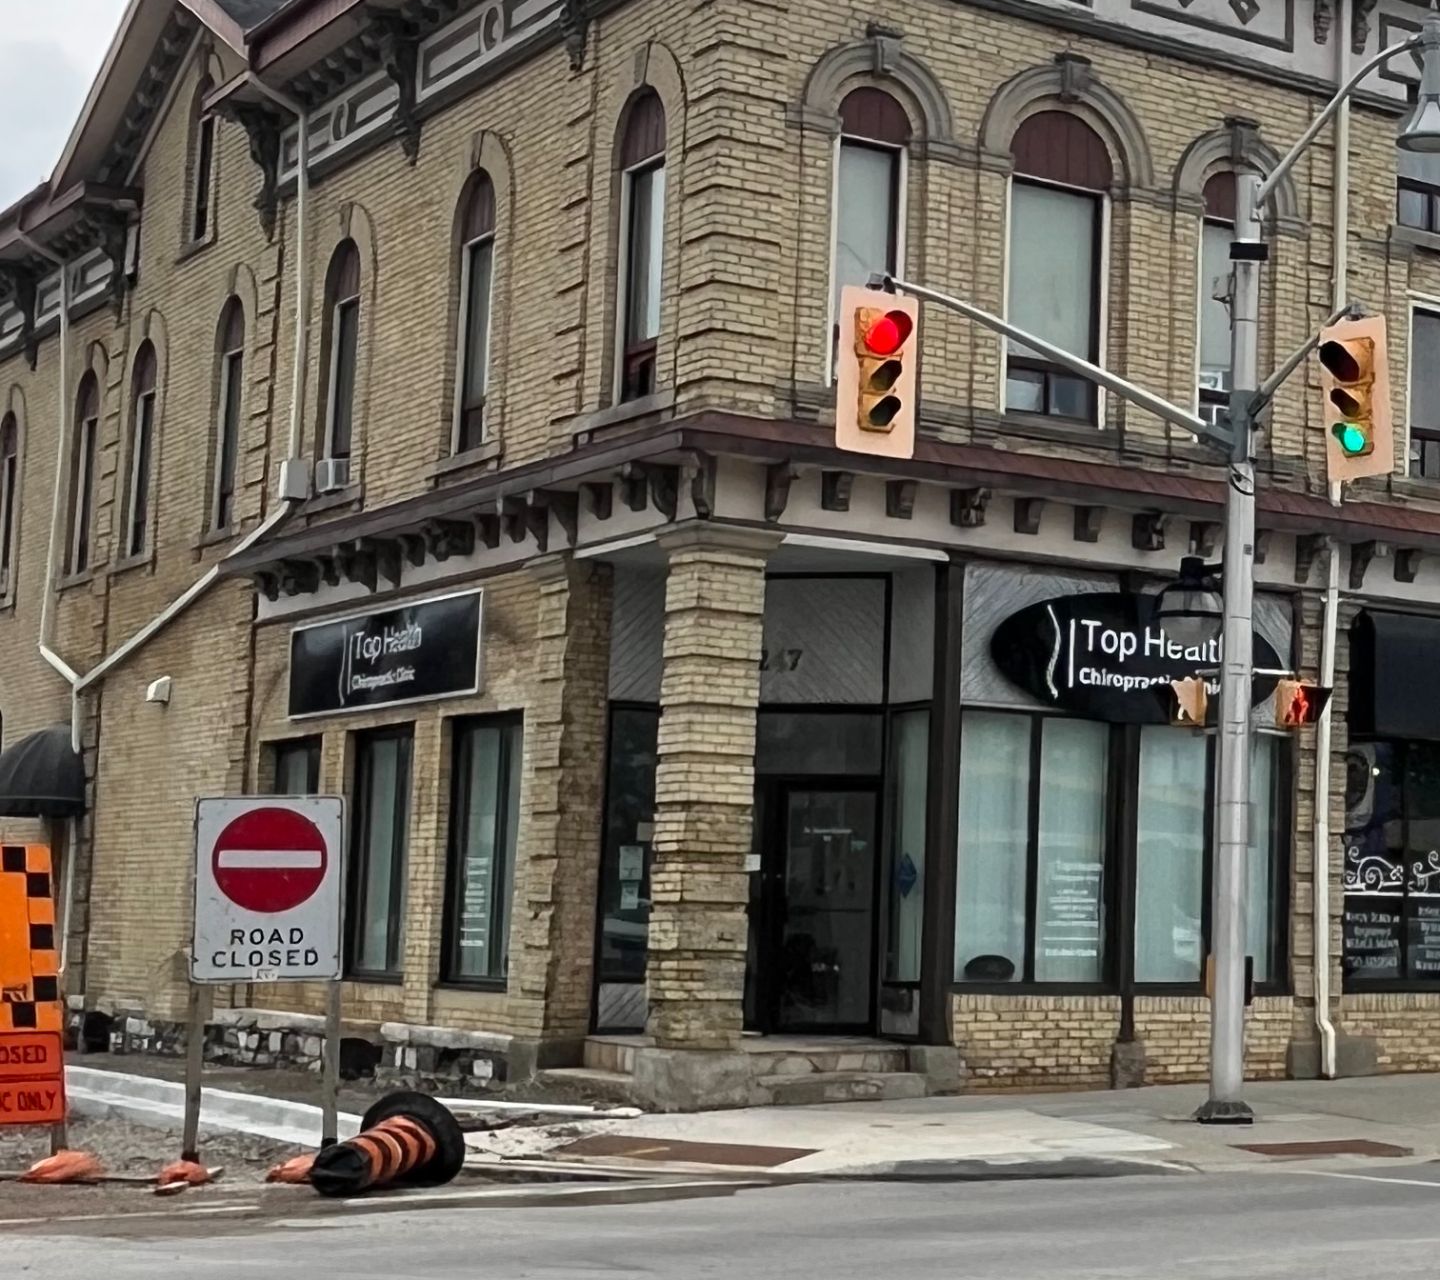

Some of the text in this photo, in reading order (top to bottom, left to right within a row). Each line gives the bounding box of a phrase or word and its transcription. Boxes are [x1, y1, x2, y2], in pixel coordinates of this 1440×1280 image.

[355, 631, 382, 665] Top
[1080, 619, 1138, 662] Top
[229, 927, 304, 946] ROAD
[211, 949, 320, 968] CLOSED
[17, 1090, 57, 1112] ONLY
